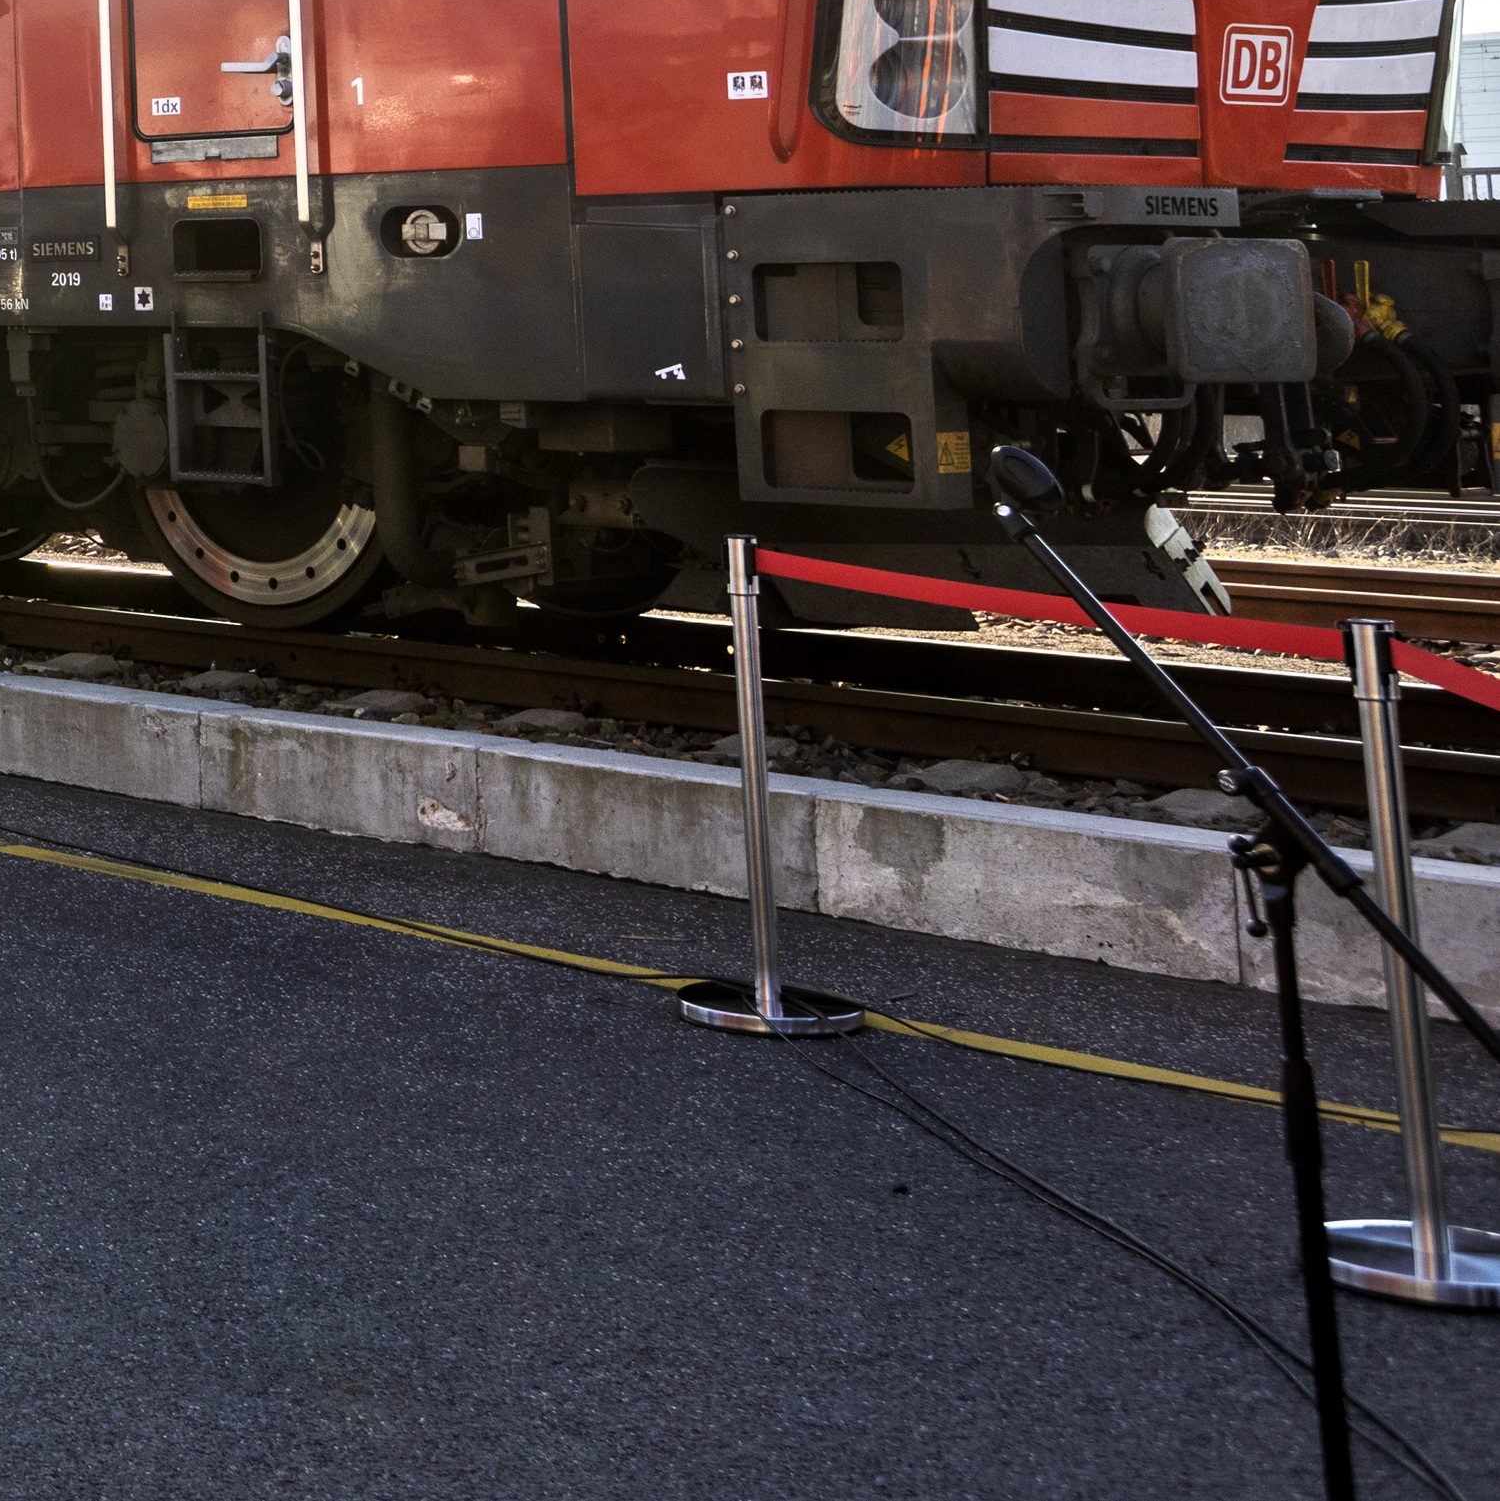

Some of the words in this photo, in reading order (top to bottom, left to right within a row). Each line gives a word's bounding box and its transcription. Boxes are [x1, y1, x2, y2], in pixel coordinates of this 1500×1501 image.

[153, 100, 179, 114] 1dx
[1144, 195, 1219, 218] SIEMENS
[32, 241, 94, 257] SIEMENS
[51, 272, 81, 287] 2019
[0, 299, 13, 310] 56
[15, 298, 29, 310] kN
